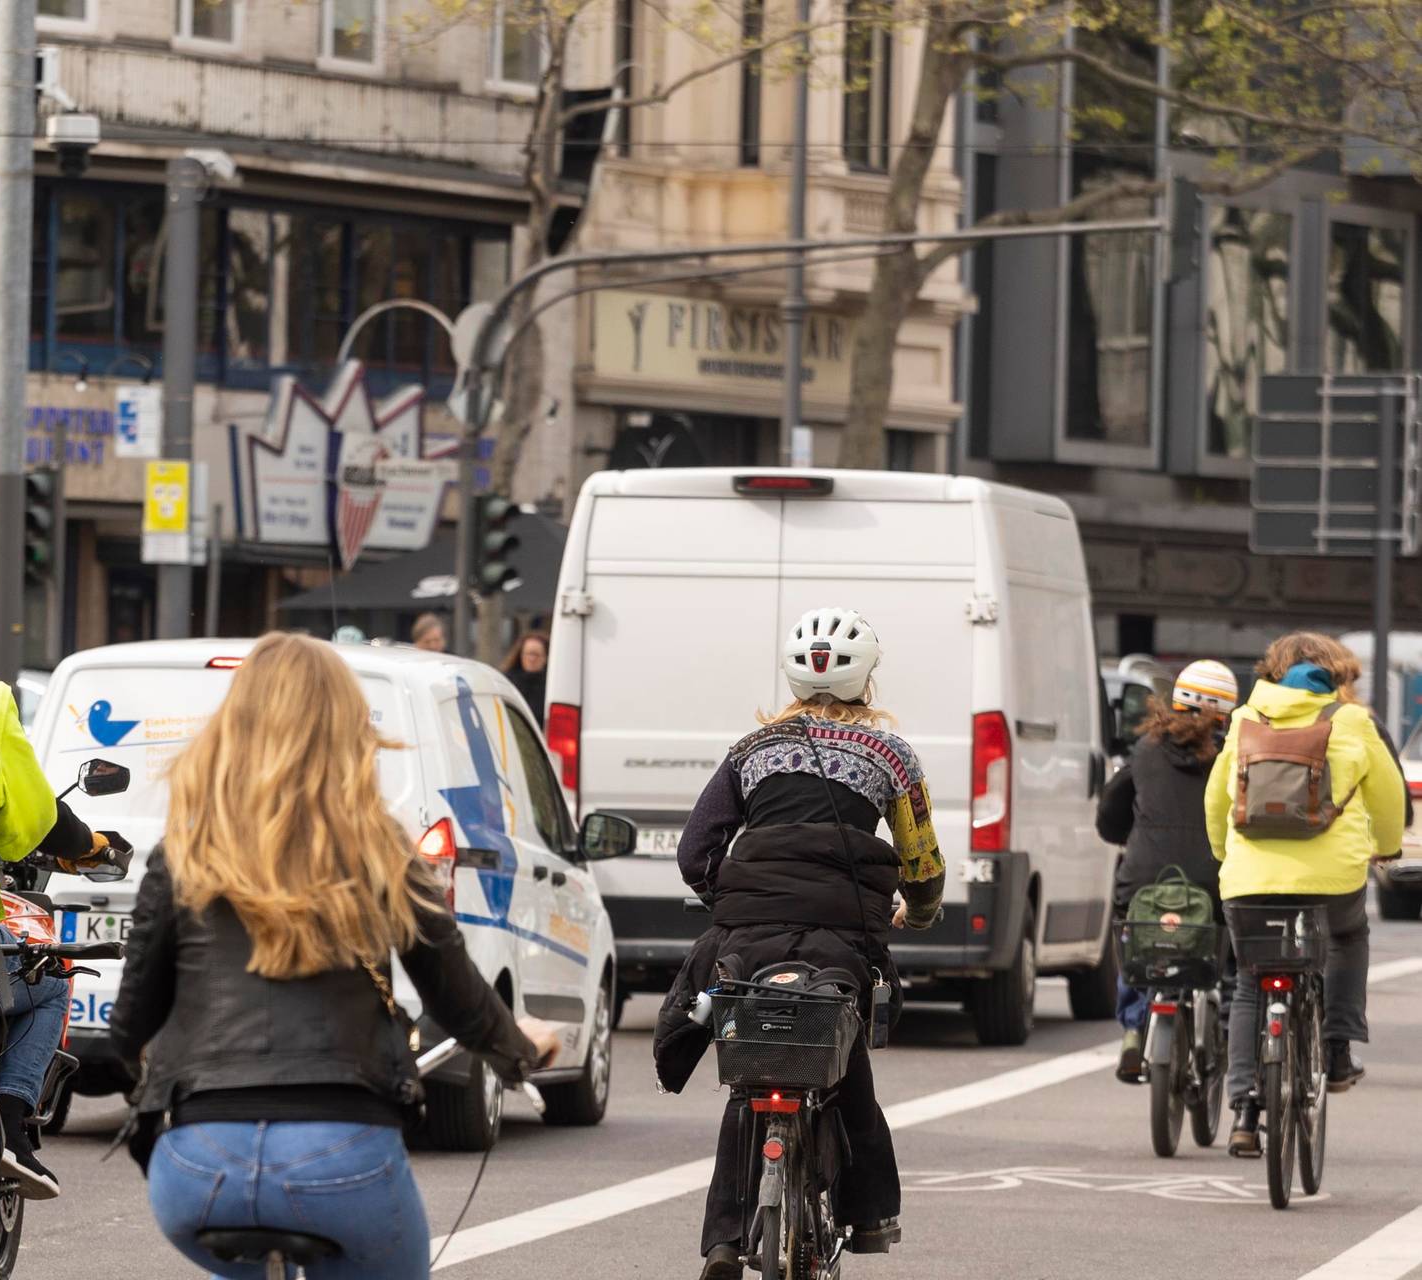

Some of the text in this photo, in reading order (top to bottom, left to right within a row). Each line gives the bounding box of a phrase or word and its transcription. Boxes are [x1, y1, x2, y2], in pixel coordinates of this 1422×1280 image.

[624, 758, 716, 769] DUCATO
[86, 916, 104, 941] K
[70, 993, 115, 1024] ele
